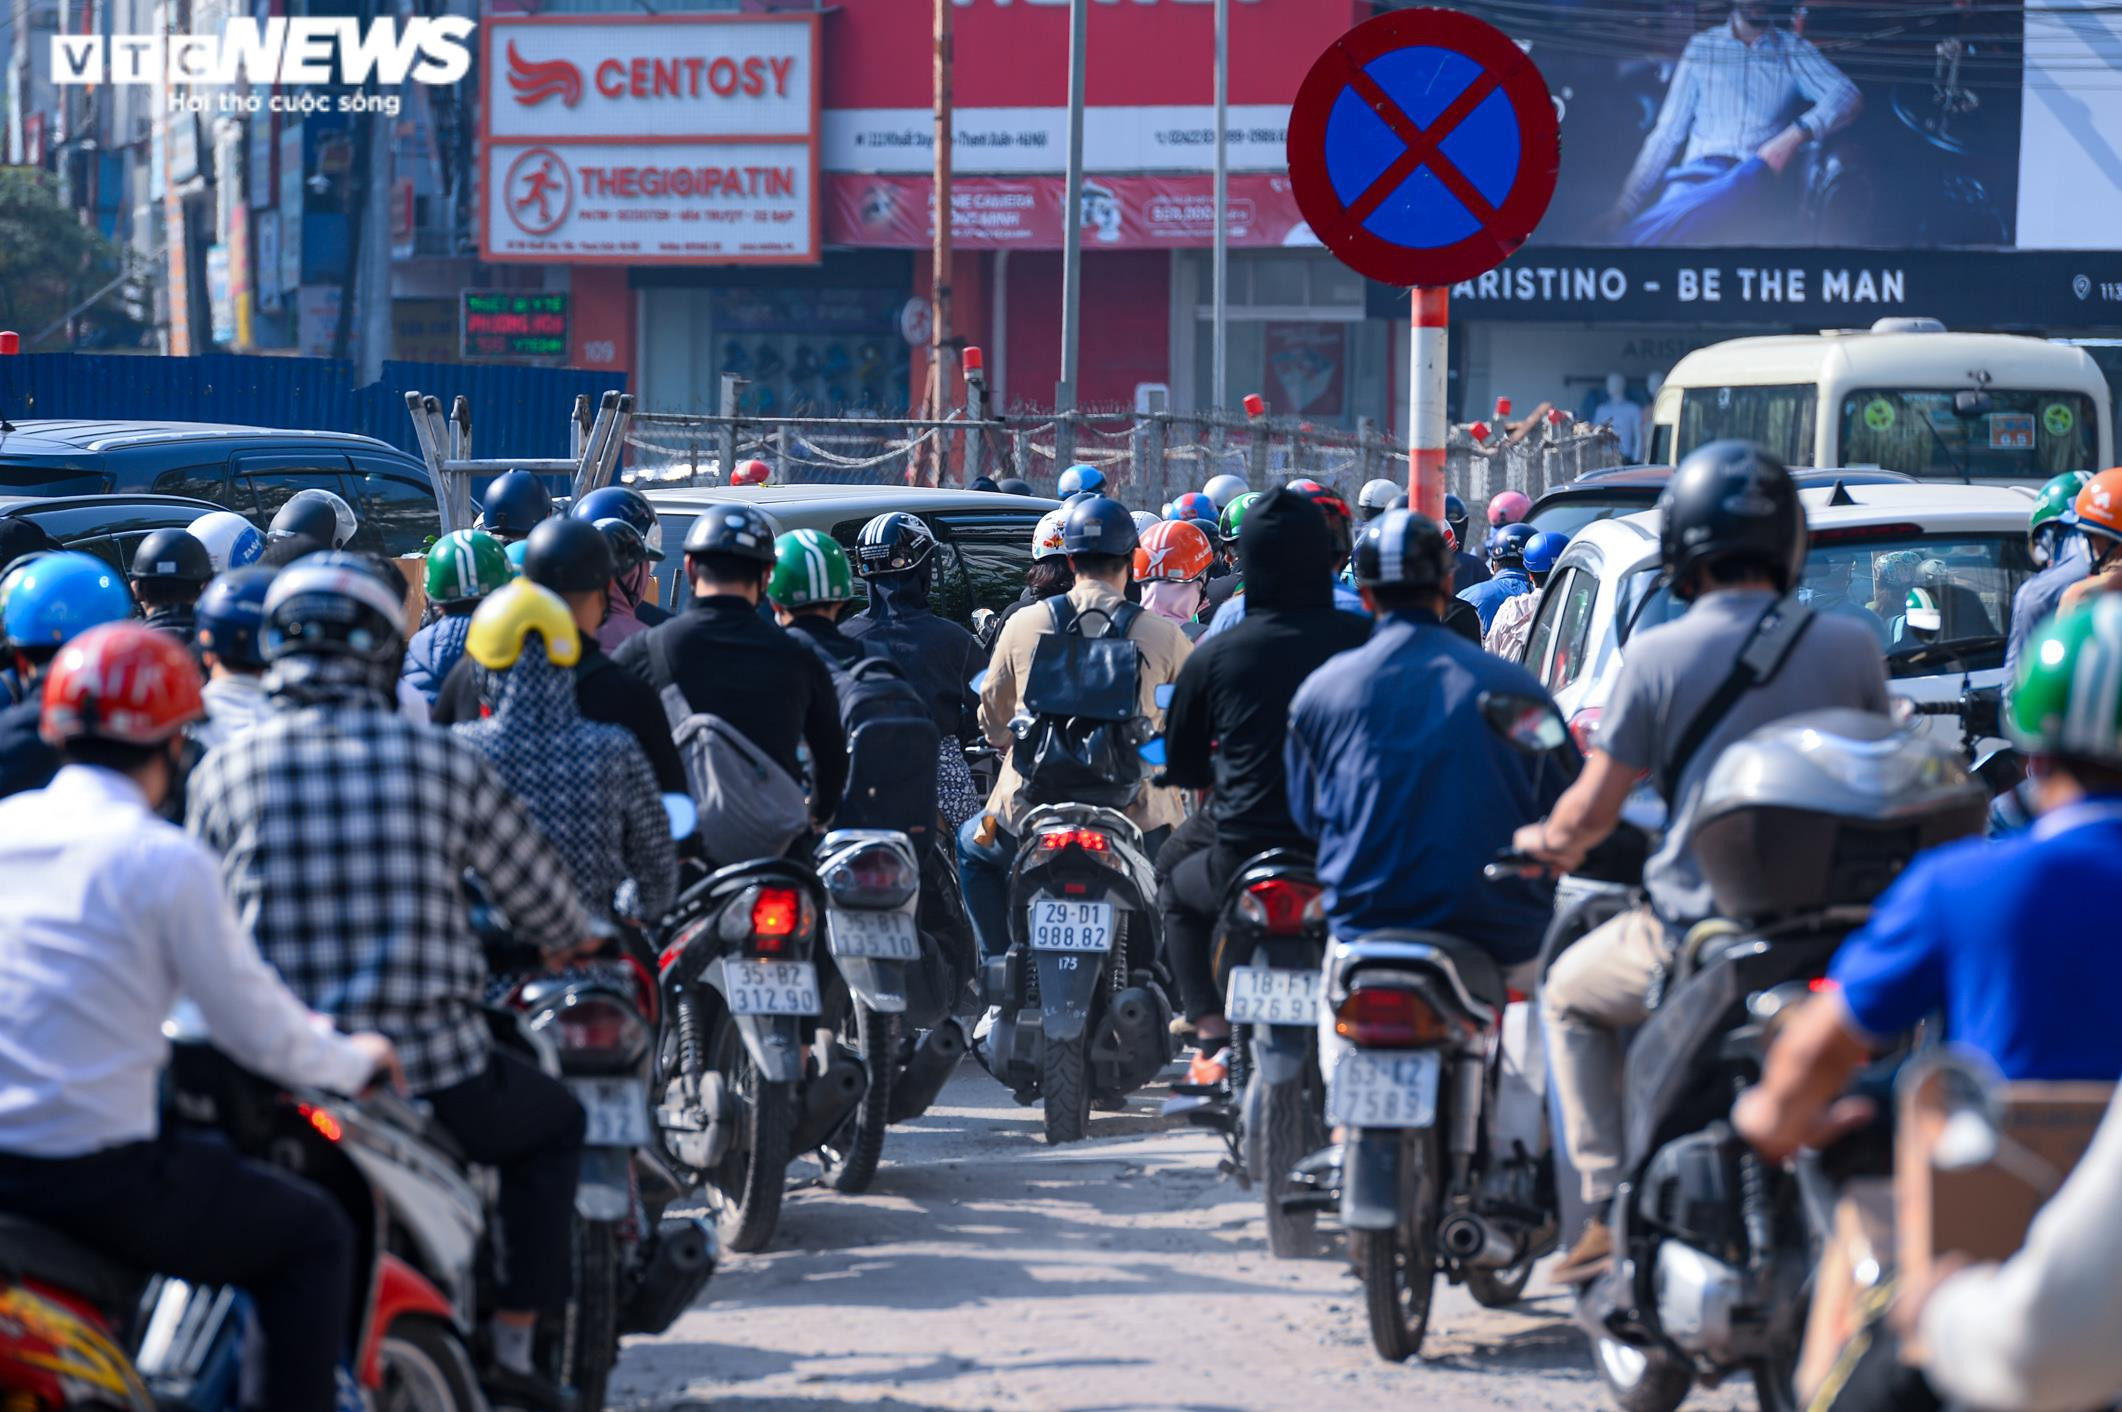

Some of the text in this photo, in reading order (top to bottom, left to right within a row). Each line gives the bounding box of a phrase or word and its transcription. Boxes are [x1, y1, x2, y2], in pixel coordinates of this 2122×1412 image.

[596, 57, 794, 99] CENTOSY
[1678, 268, 1721, 301] BE
[1737, 268, 1806, 302] THE
[1822, 269, 1905, 303] MAN
[1045, 903, 1100, 925] 29-D1
[840, 934, 913, 956] 135.10
[1037, 926, 1106, 948] 988.82
[735, 989, 814, 1011] 312.90
